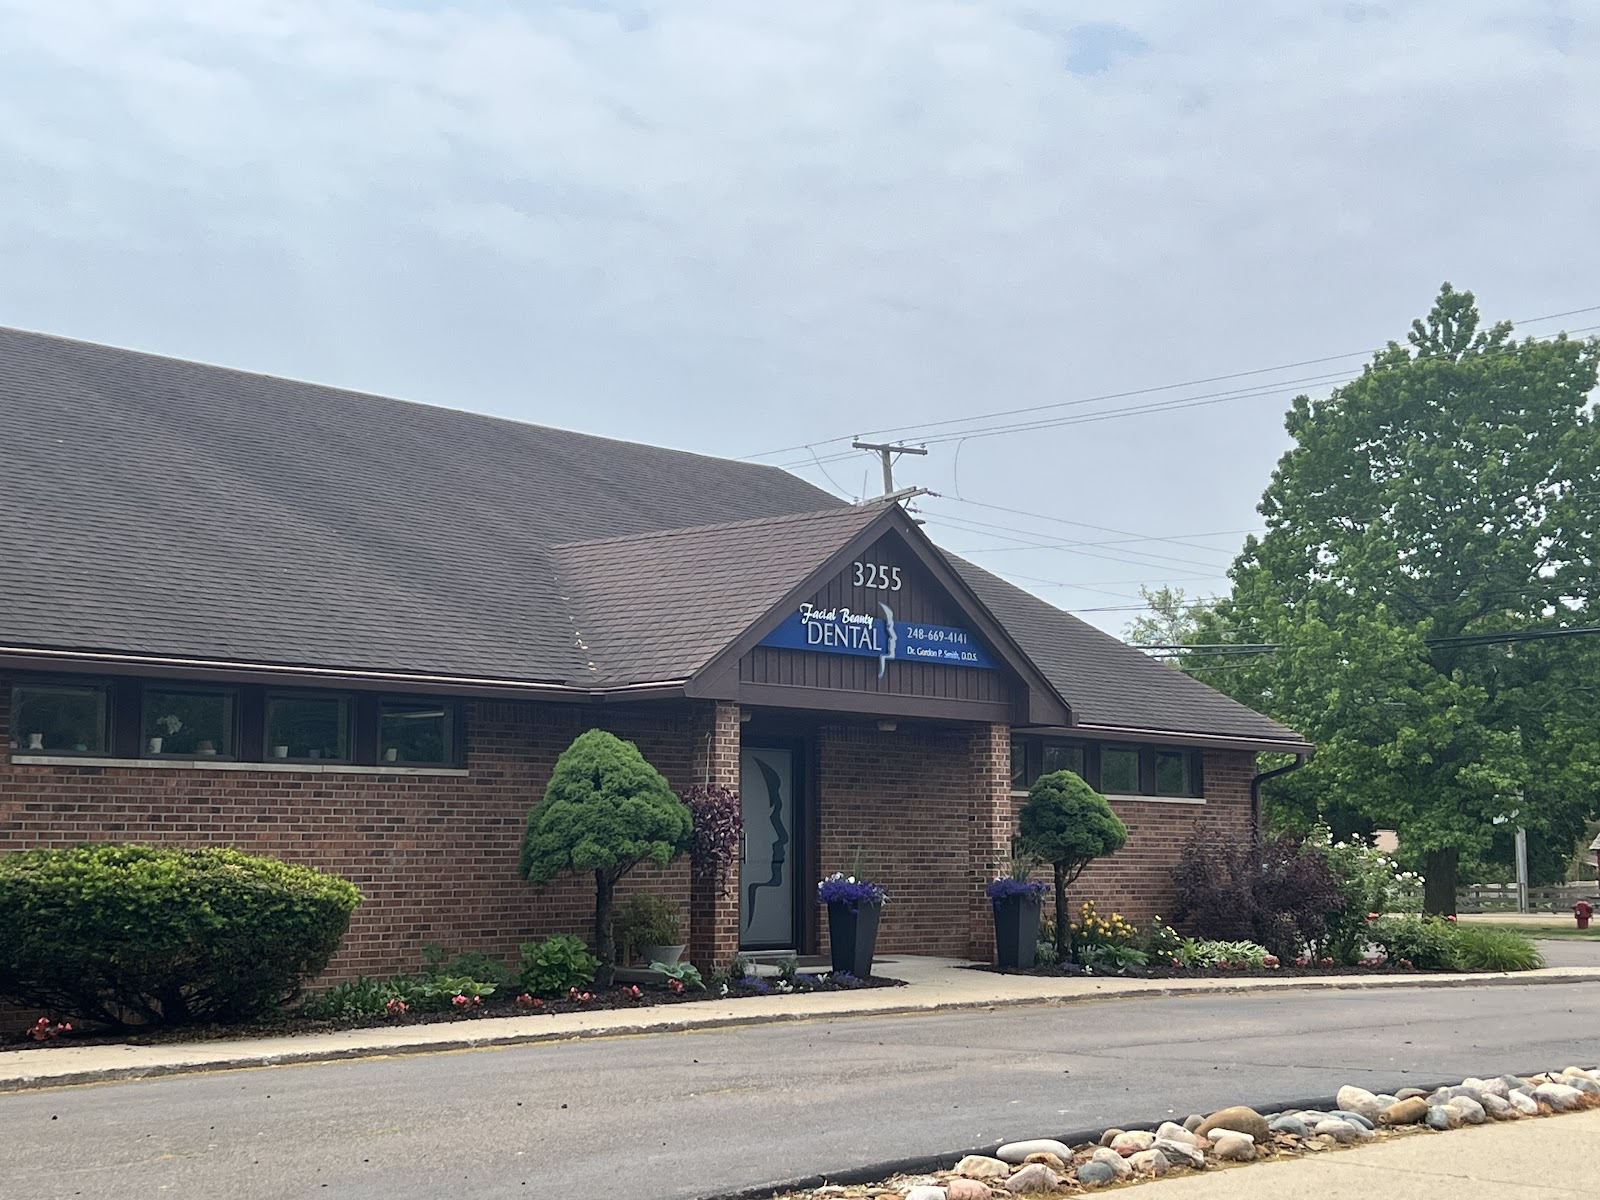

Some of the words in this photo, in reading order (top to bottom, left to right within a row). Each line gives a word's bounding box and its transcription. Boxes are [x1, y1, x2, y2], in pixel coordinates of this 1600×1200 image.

[853, 561, 902, 591] 3255
[799, 602, 837, 624] Facial
[839, 607, 874, 630] Beauty
[807, 621, 882, 651] DENTAL
[907, 627, 967, 644] 248-669-4141
[907, 646, 916, 655] Dr.
[916, 647, 938, 657] Gordon
[938, 649, 943, 658] P.
[944, 649, 960, 660] Smith,
[961, 652, 979, 661] D.D.S.
